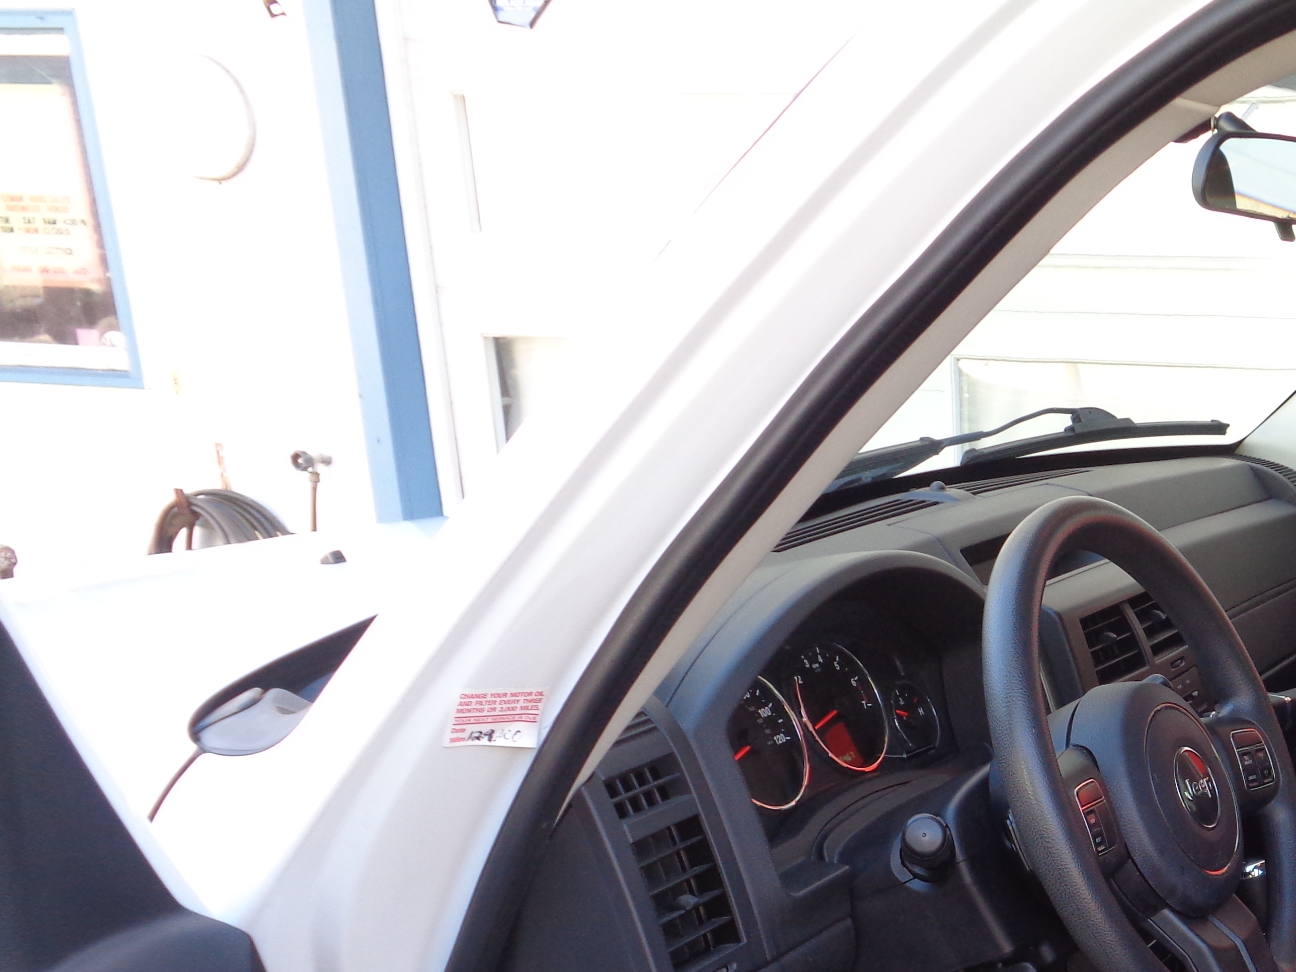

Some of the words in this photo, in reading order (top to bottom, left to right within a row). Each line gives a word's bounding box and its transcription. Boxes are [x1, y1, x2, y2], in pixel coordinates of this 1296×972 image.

[758, 707, 772, 718] 100
[773, 733, 786, 745] 120
[1184, 776, 1213, 801] Jeep
